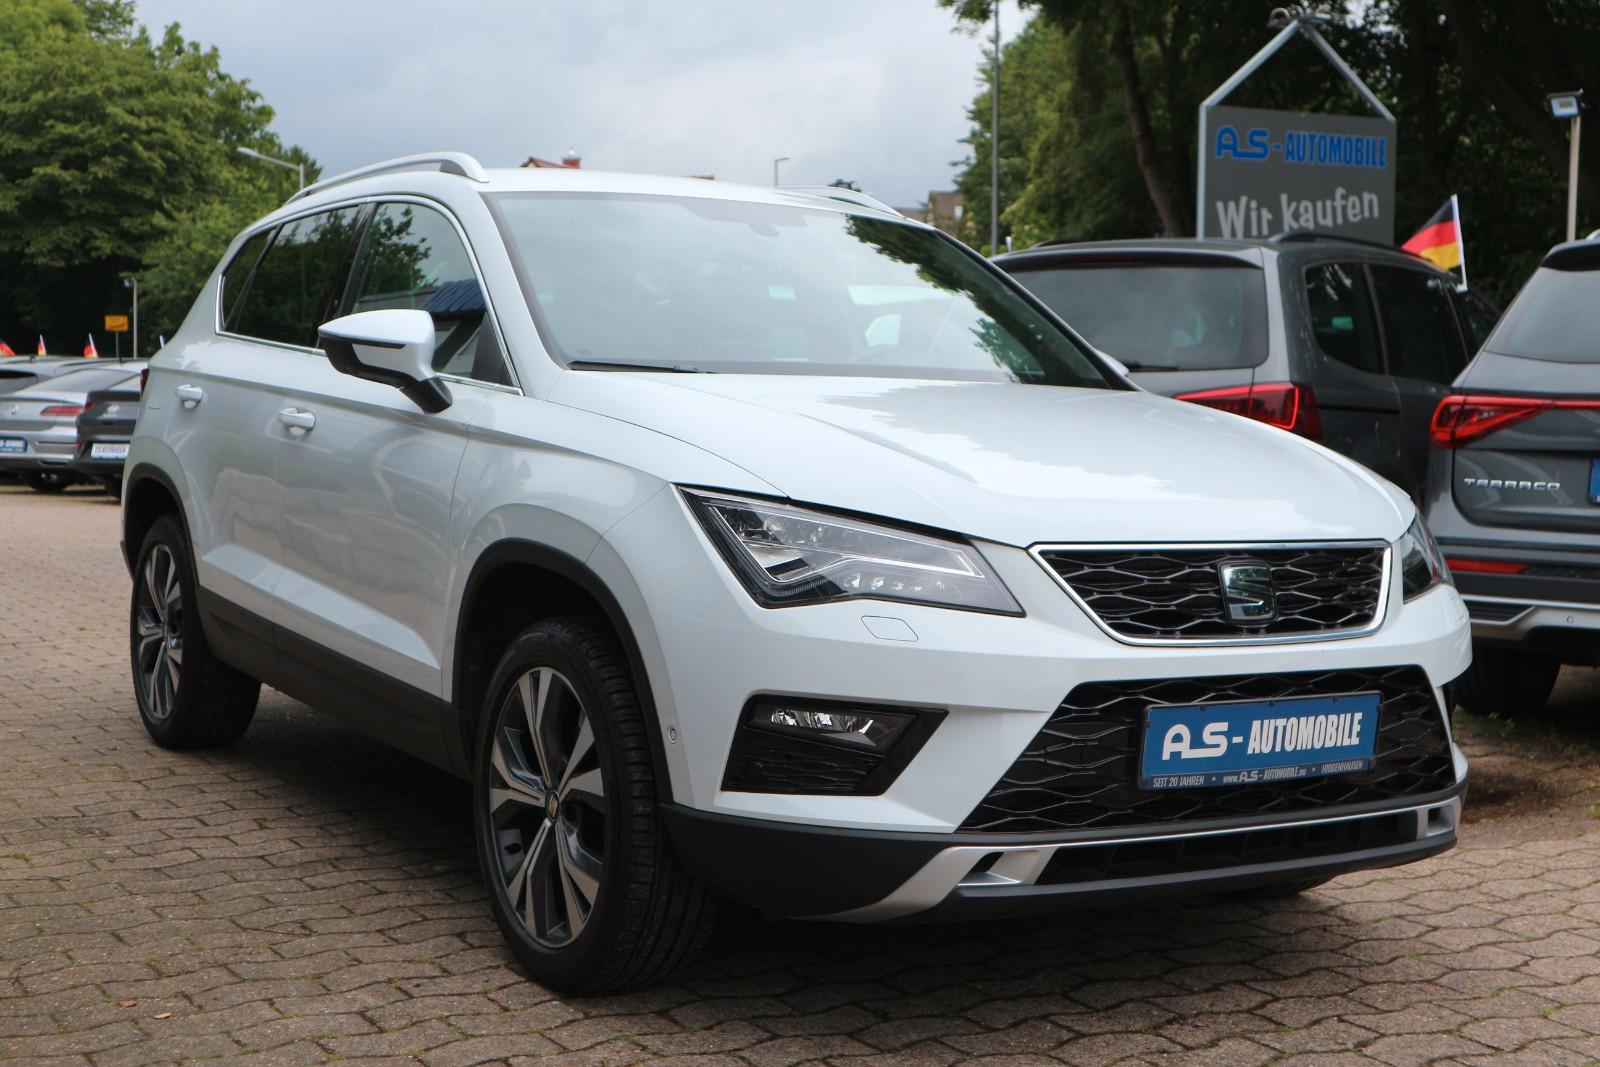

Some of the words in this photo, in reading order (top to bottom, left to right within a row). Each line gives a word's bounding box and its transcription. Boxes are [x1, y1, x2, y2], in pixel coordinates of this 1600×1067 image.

[1215, 195, 1273, 240] Wir
[1279, 186, 1380, 233] kaufen
[1463, 477, 1561, 491] TARRACO
[1153, 777, 1168, 788] SEIT
[1168, 777, 1178, 787] 20
[1179, 775, 1205, 786] JAHREN
